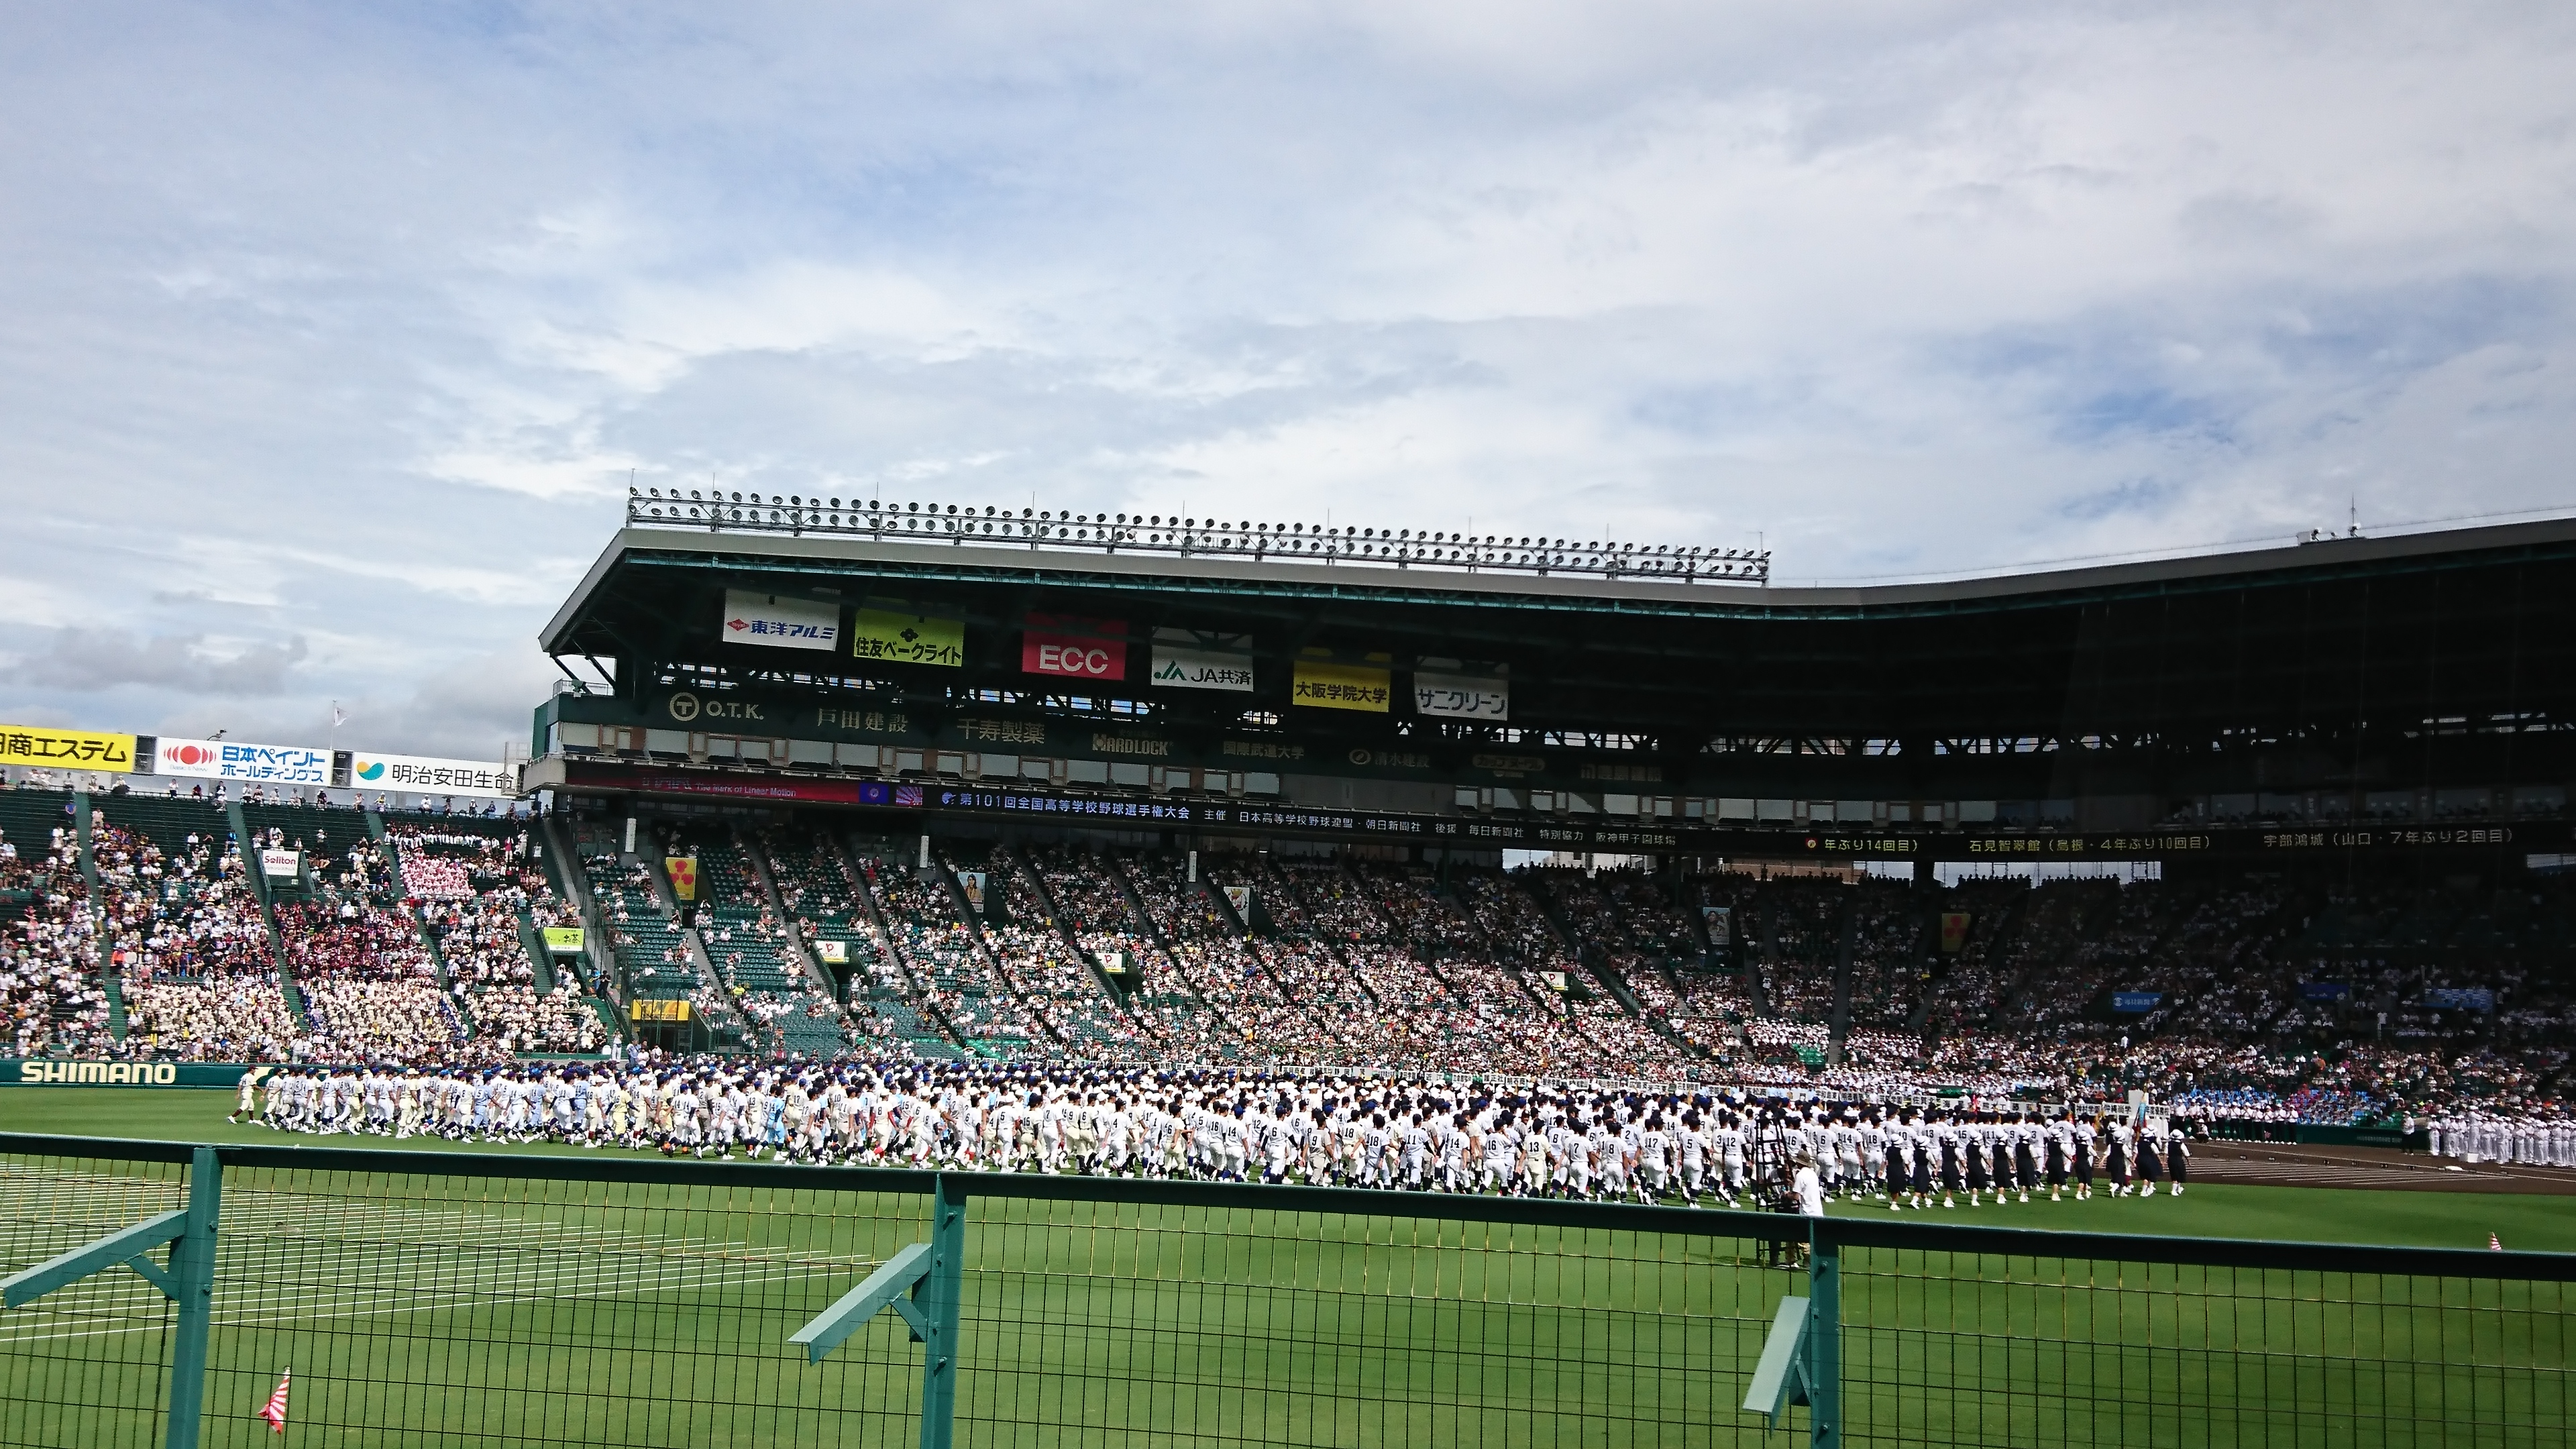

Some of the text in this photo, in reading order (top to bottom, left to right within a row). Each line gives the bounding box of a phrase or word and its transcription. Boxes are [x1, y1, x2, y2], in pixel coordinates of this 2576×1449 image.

[751, 620, 836, 639] 東洋アルミ
[856, 637, 961, 664] 住友ベークライト
[1040, 645, 1108, 674] ECC
[1191, 668, 1251, 686] JA共済
[1295, 681, 1388, 703] 大阪学院大学
[1419, 688, 1505, 714] サニクリーン
[706, 701, 764, 720] O.T.K.
[816, 708, 908, 733] 戸田建設
[957, 718, 1045, 744] 千寿製薬
[1224, 741, 1305, 759] 国際武道大学
[222, 745, 325, 766] 日本ペイント
[221, 764, 323, 783] ホールディングス
[392, 764, 515, 789] 明治安田生命
[959, 793, 1190, 820] 第101回全国高等学校野球選手権大会
[1204, 810, 1226, 821] 主催
[1435, 823, 1456, 834] 後援
[1468, 824, 1524, 838] 毎日新聞社
[1540, 829, 1583, 841] 特別協力
[264, 855, 296, 865] Soliton
[21, 1061, 176, 1084] SHIMANO
[749, 1097, 755, 1106] 13
[834, 1094, 841, 1102] 10
[878, 1107, 882, 1115] 8
[916, 1107, 920, 1115] 6
[1046, 1110, 1051, 1119] 7
[1069, 1111, 1073, 1120] 9
[965, 1113, 970, 1122] 6
[1000, 1112, 1006, 1121] 5
[1082, 1112, 1087, 1120] 6
[1128, 1112, 1133, 1121] 9
[1023, 1117, 1030, 1126] 16
[1113, 1118, 1118, 1128] 4
[1199, 1116, 1203, 1126] 5
[1254, 1120, 1261, 1129] 12
[1295, 1118, 1299, 1127] 6
[1587, 1118, 1592, 1126] 5
[1167, 1125, 1172, 1134] 6
[1211, 1122, 1219, 1131] 16
[1667, 1122, 1675, 1130] 14
[1744, 1125, 1749, 1133] 8
[1228, 1127, 1236, 1136] 14
[1272, 1127, 1277, 1137] 6
[1344, 1128, 1354, 1138] 18
[1625, 1130, 1631, 1140] 2
[1926, 1130, 1933, 1138] 13
[1958, 1130, 1966, 1139] 15
[1986, 1131, 1994, 1139] 11
[1312, 1136, 1318, 1146] 9
[1369, 1136, 1379, 1146] 18
[1407, 1135, 1416, 1144] 11
[1553, 1134, 1558, 1143] 8
[1589, 1132, 1595, 1142] 6
[1717, 1135, 1721, 1144] 3
[1727, 1137, 1735, 1146] 12
[1788, 1136, 1796, 1145] 16
[1821, 1136, 1825, 1144] 6
[1843, 1134, 1851, 1143] 14
[1868, 1135, 1877, 1144] 18
[1450, 1138, 1460, 1148] 14
[1488, 1140, 1497, 1150] 16
[1529, 1142, 1539, 1152] 13
[1648, 1138, 1658, 1148] 17
[1687, 1139, 1693, 1148] 5
[1574, 1143, 1578, 1153] 7
[1609, 1144, 1614, 1154] 8
